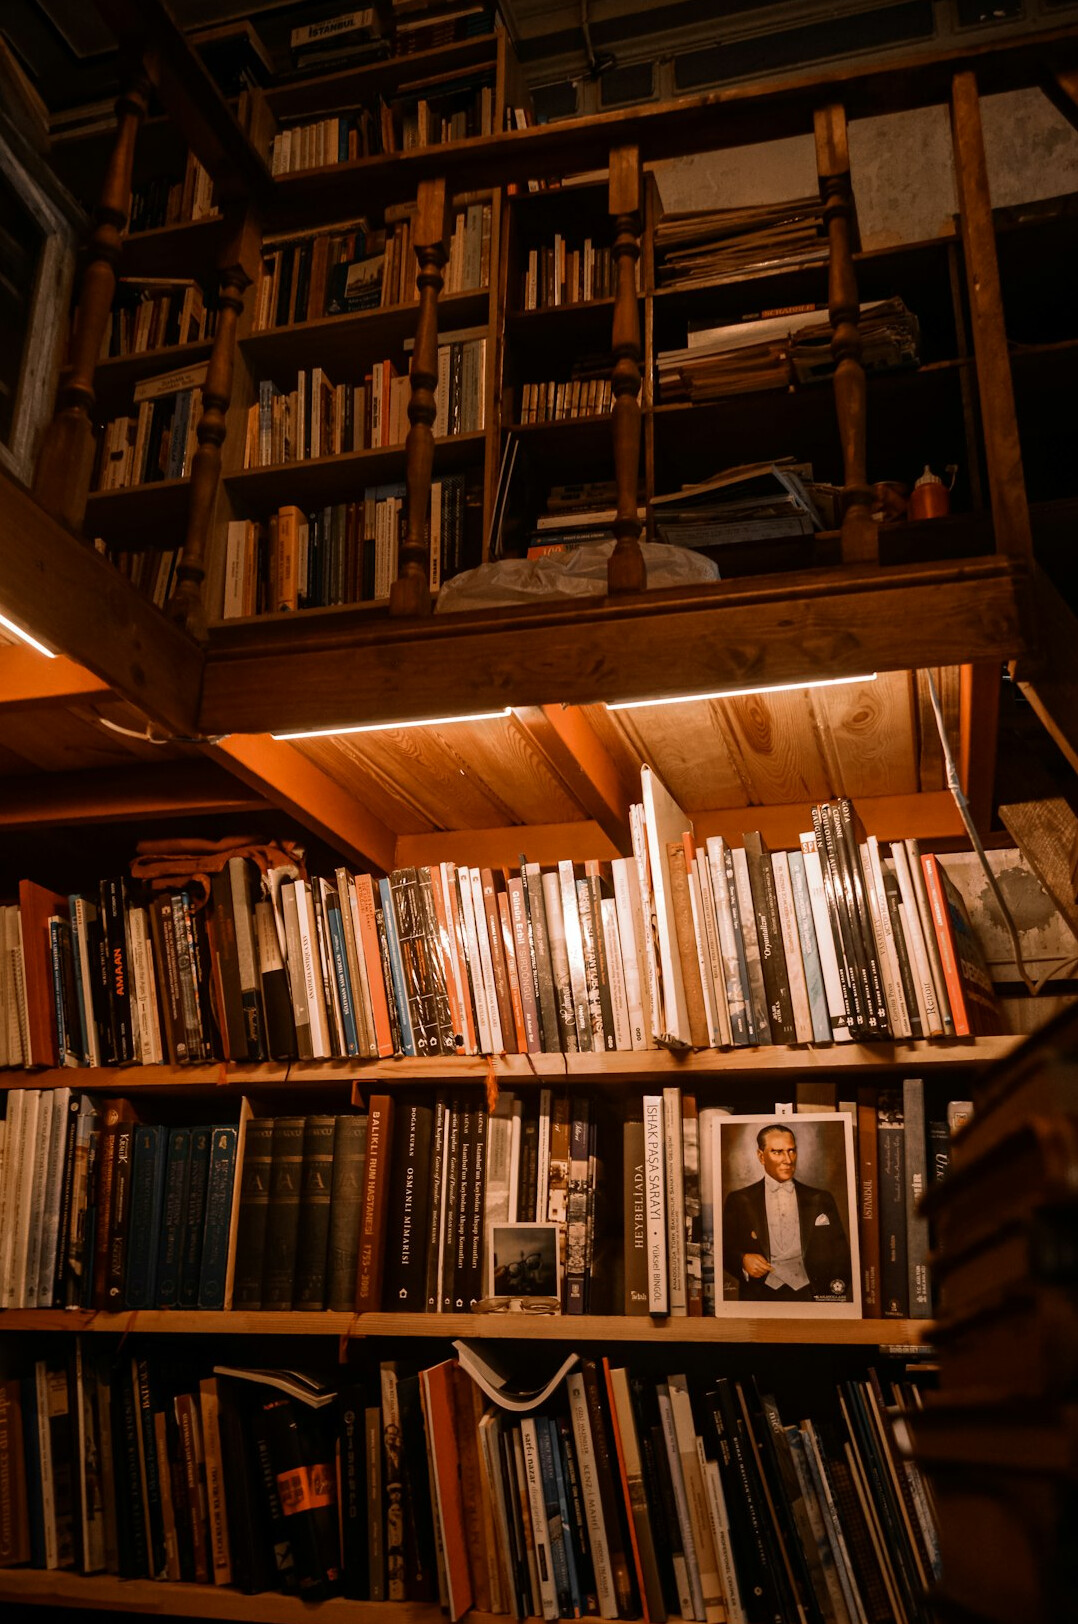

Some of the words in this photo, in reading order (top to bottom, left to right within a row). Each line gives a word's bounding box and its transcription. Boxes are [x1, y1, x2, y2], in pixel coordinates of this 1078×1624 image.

[841, 800, 851, 823] GOYA
[811, 809, 823, 847] GAUGUIN
[510, 891, 523, 921] Gülsün
[515, 922, 525, 944] Erbil
[113, 948, 124, 996] AMAAN
[304, 946, 312, 971] ANTIQUA
[588, 953, 596, 971] ANY
[306, 972, 315, 999] ANATOLIA
[890, 998, 899, 1021] Corvina
[410, 1107, 418, 1131] DOĞAN
[647, 1104, 660, 1139] İSHAK
[144, 1136, 151, 1149] 1
[196, 1136, 206, 1150] 3
[218, 1135, 228, 1149] 4
[370, 1111, 381, 1155] BALIKLI
[408, 1133, 416, 1156] KUBAN
[368, 1158, 377, 1179] RUM
[434, 1155, 442, 1169] Gates
[449, 1157, 457, 1170] Gates
[460, 1143, 470, 1180] İstanbul'un
[475, 1142, 485, 1180] İstanbul'un
[646, 1142, 660, 1173] PAŞA
[433, 1169, 441, 1179] of
[449, 1170, 457, 1179] of
[634, 1165, 644, 1209] HEYBELİADA
[405, 1168, 415, 1212] OSMANLI
[433, 1179, 441, 1205] Paradise
[448, 1180, 456, 1206] Paradise
[458, 1181, 468, 1212] Kaybolan
[473, 1181, 482, 1212] Kaybolan
[649, 1175, 661, 1221] SARAYI
[364, 1181, 376, 1234] HASTANESİ
[457, 1214, 466, 1234] Ahşap
[472, 1214, 481, 1234] Ahşap
[401, 1216, 412, 1265] MİMARİSİ
[457, 1236, 466, 1269] Konutları
[472, 1236, 480, 1269] Konutları
[652, 1244, 661, 1271] Yüksel
[653, 1273, 663, 1302] BİNGÖL
[524, 1433, 533, 1456] sarf-ı
[527, 1458, 535, 1483] nazar
[583, 1464, 594, 1495] KENZ-İ
[530, 1485, 542, 1532] disregarded
[719, 1530, 730, 1573] PROFESYONEL
[726, 1576, 736, 1606] ÇEKİMLER
